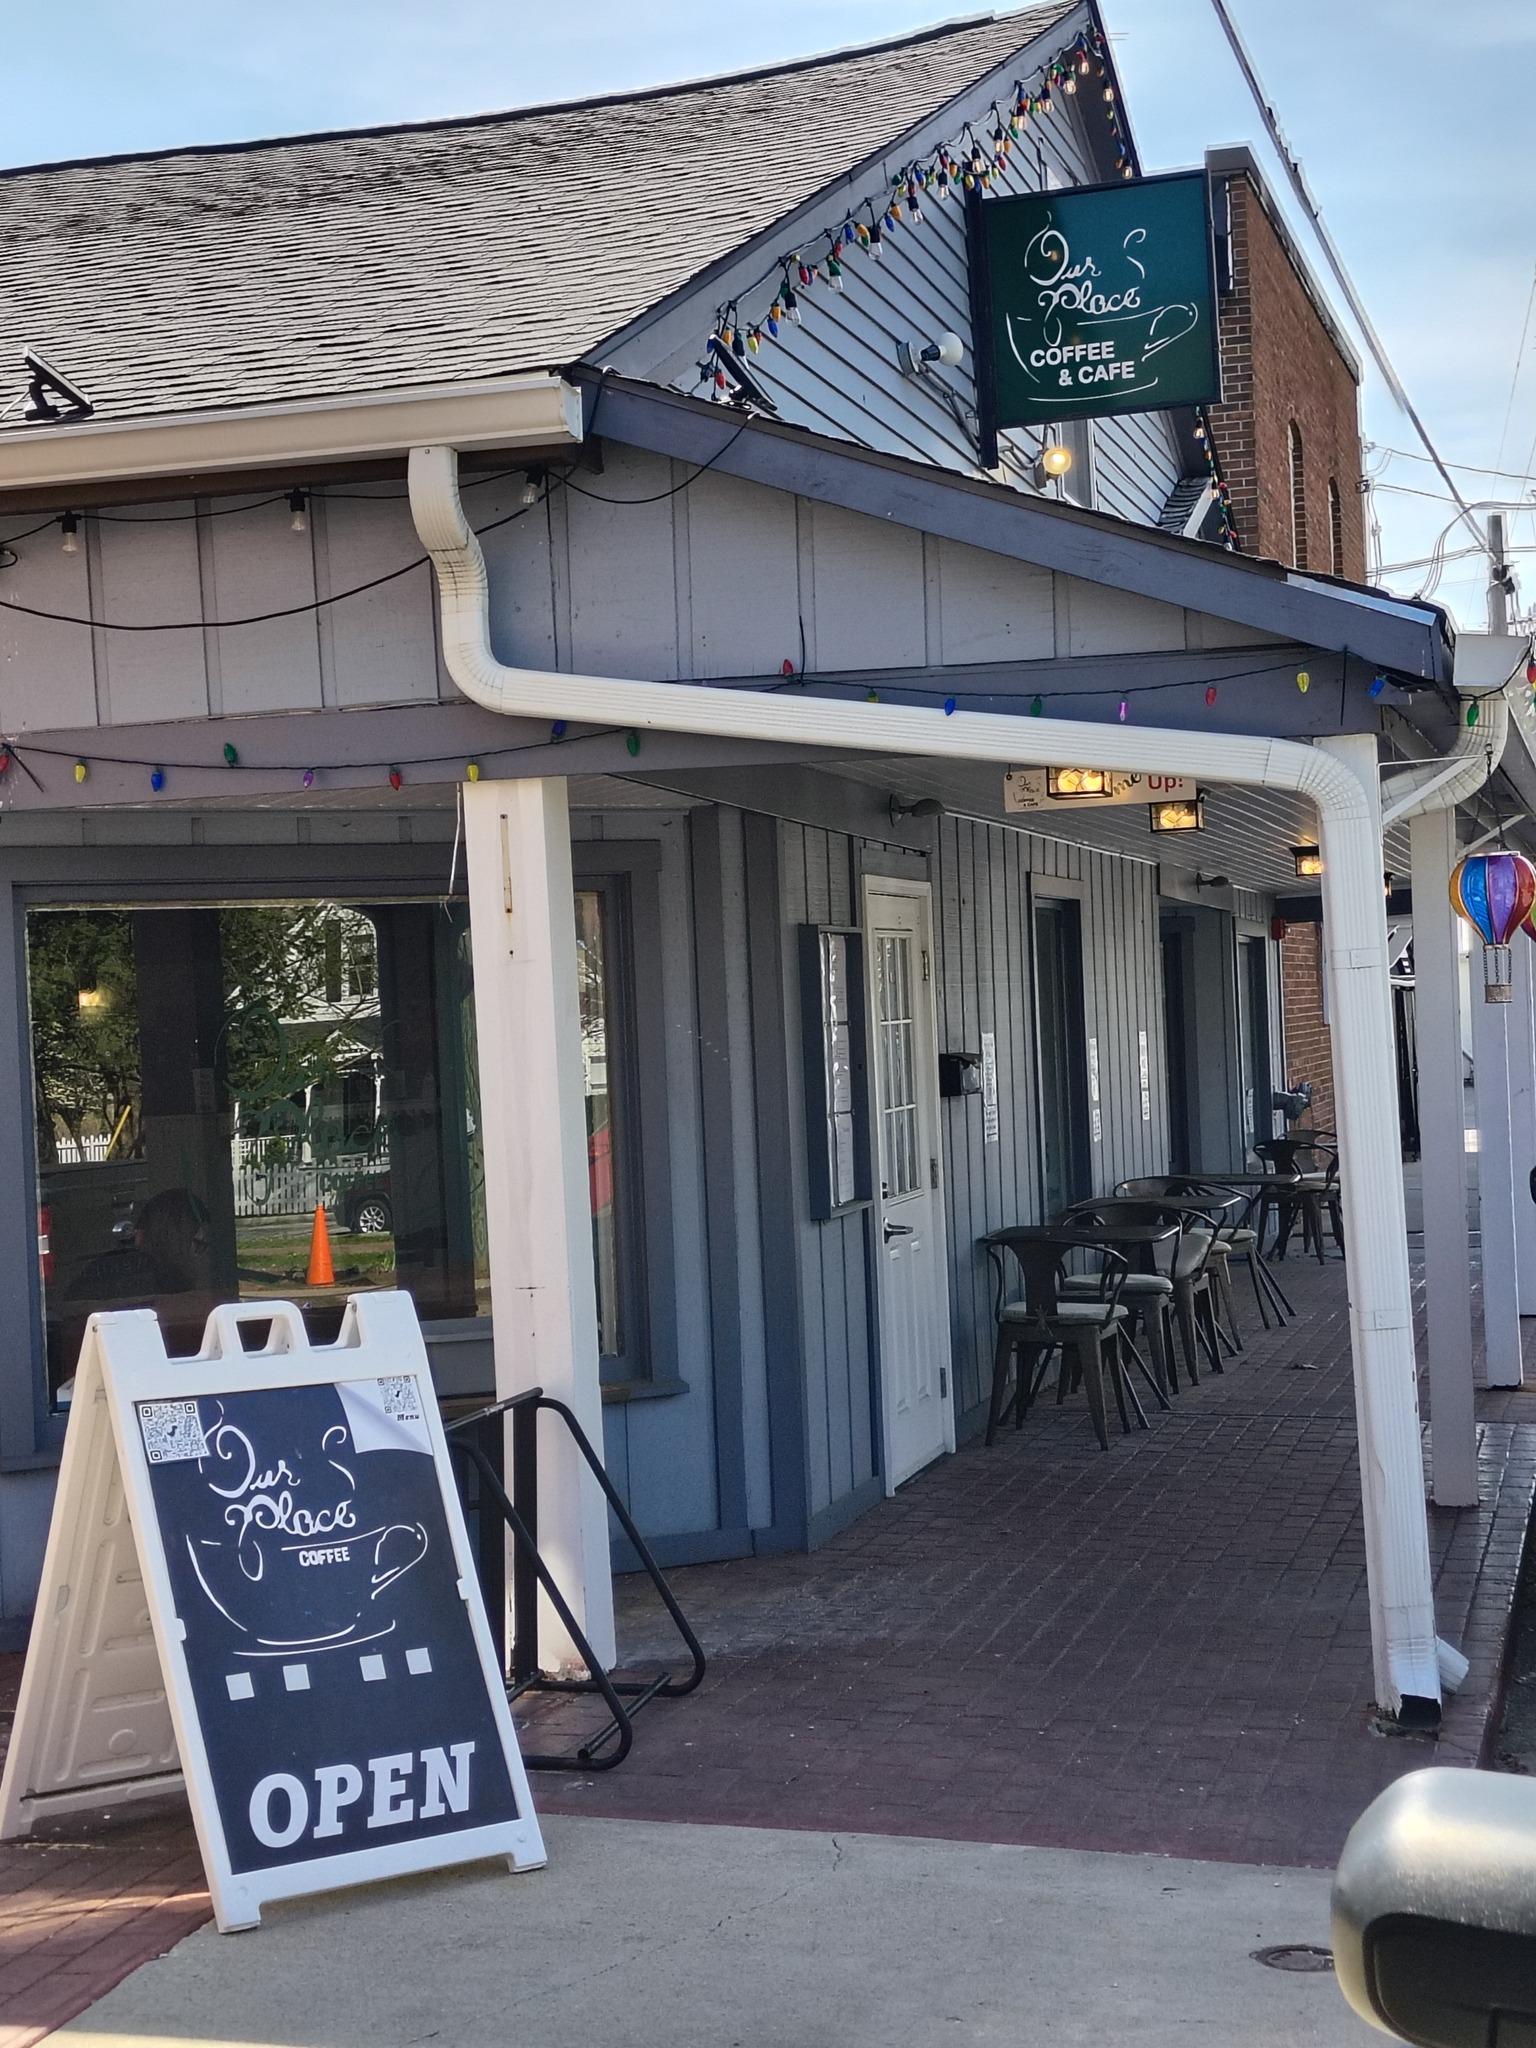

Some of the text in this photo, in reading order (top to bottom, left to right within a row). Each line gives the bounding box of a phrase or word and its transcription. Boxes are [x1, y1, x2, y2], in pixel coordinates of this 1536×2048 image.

[1024, 226, 1101, 286] Our
[1038, 280, 1141, 328] Place
[1030, 341, 1115, 367] COFFEE
[1058, 361, 1135, 386] & CAFE
[200, 1424, 300, 1498] Our
[225, 1490, 356, 1553] Place
[299, 1546, 350, 1566] COFFEE
[249, 1741, 475, 1848] OPEN
